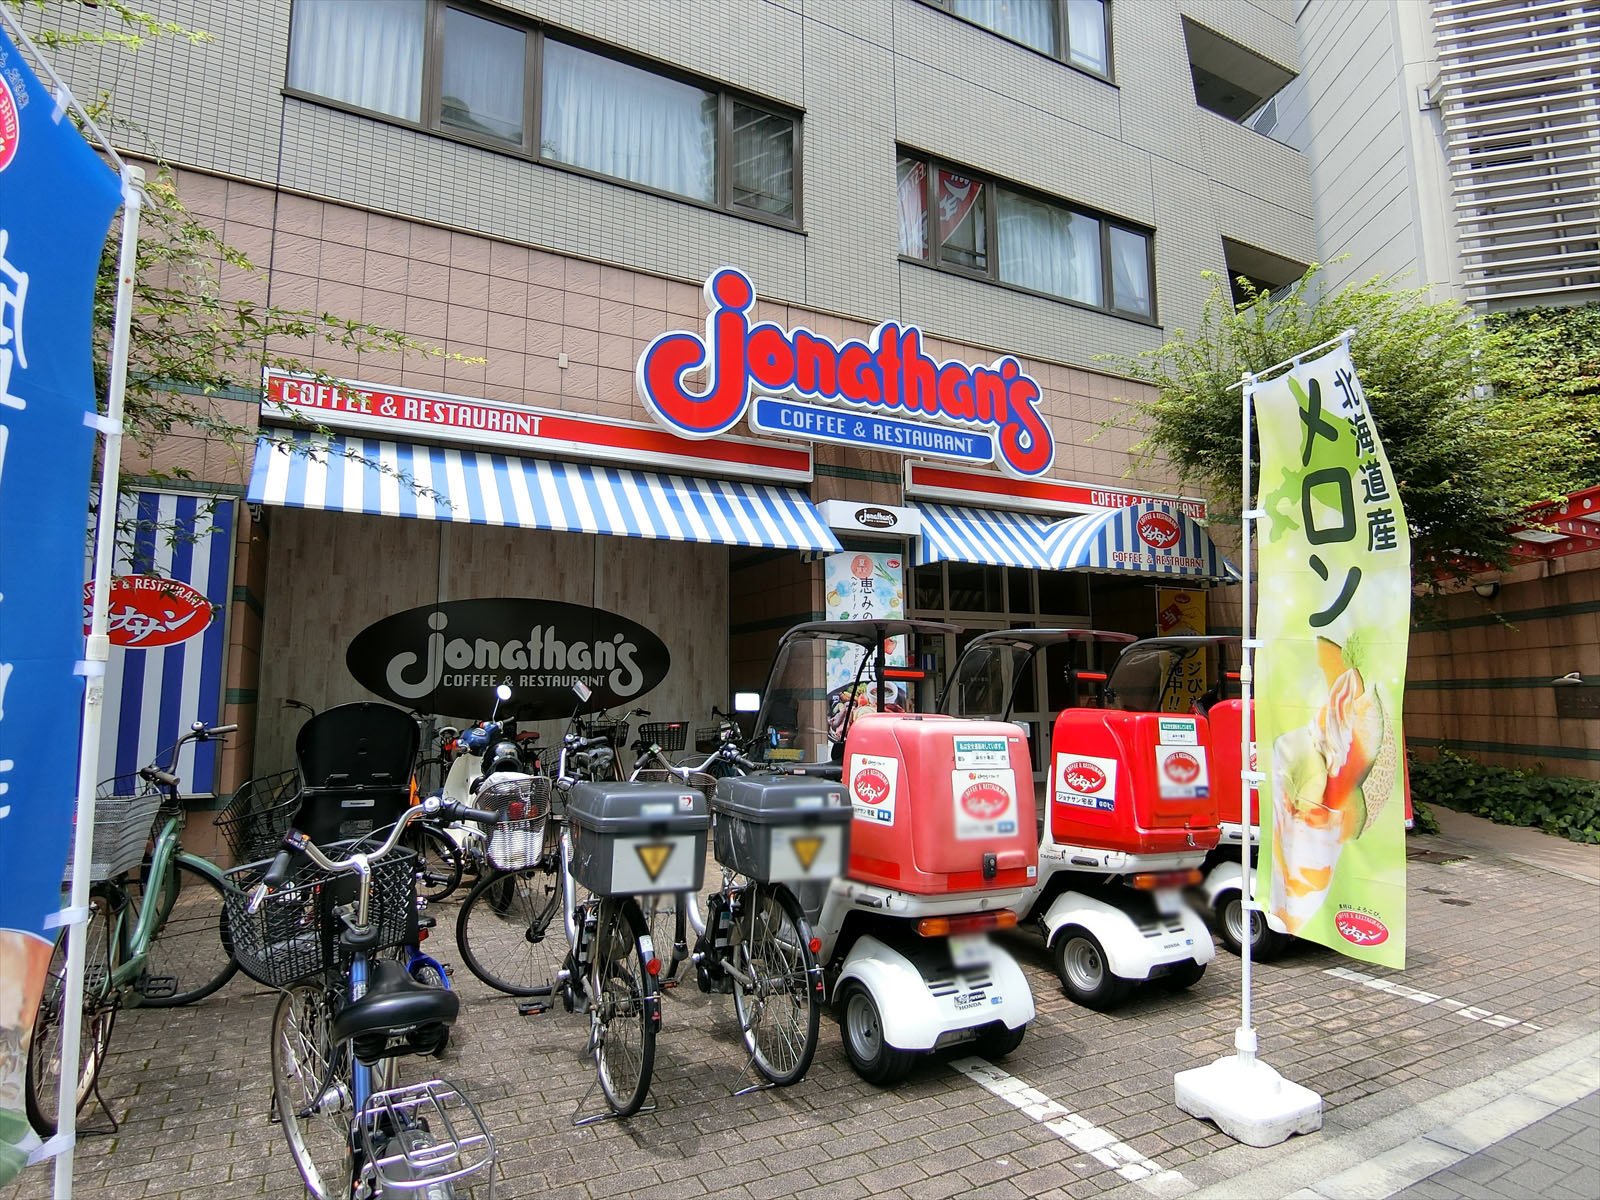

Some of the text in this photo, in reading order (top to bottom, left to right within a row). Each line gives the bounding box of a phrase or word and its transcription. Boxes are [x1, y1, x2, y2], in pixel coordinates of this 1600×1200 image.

[282, 380, 543, 437] COFFEE & RESTAURANT
[780, 408, 974, 454] COFFEE & RESTAURANT
[1334, 368, 1397, 552] 北海道産
[1090, 490, 1129, 508] COFFEE
[1131, 496, 1139, 506] &
[1300, 378, 1362, 628] メロン
[1112, 551, 1205, 569] COFFEE & RESTAURANT
[122, 580, 130, 589] &
[84, 602, 198, 644] ナサン
[386, 611, 644, 699] jonathan's
[443, 674, 606, 688] COFFEE & RESTAURANT
[959, 1001, 982, 1011] HONDA
